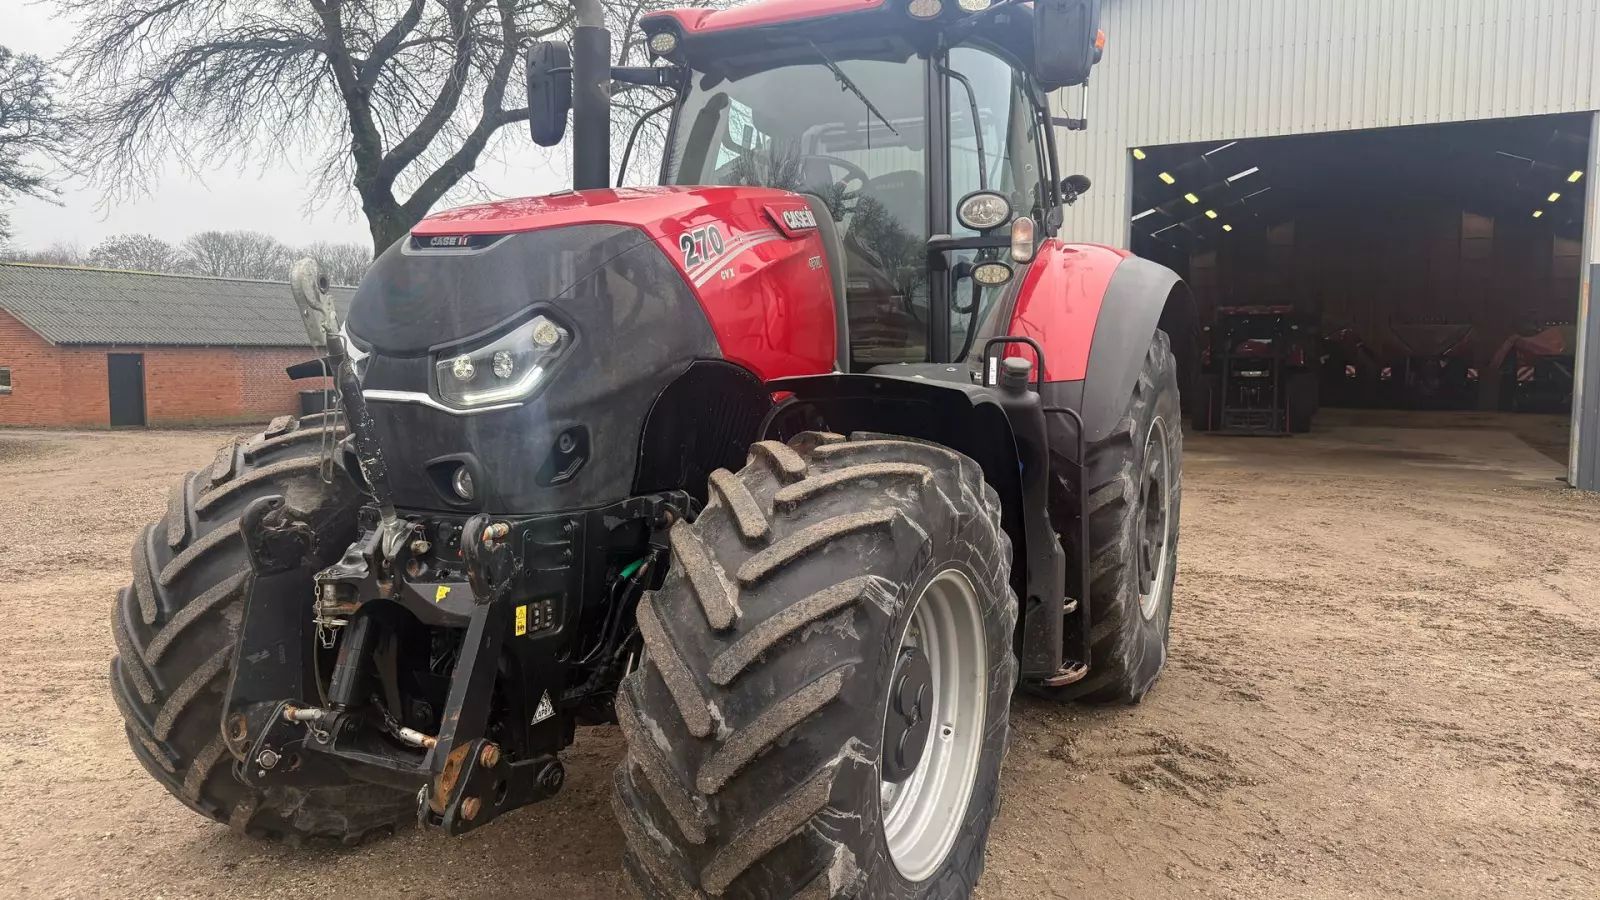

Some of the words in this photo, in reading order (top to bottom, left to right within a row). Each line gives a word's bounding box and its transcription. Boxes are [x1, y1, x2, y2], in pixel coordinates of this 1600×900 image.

[430, 236, 457, 246] CASE
[679, 224, 725, 273] 270
[720, 267, 736, 280] CVX
